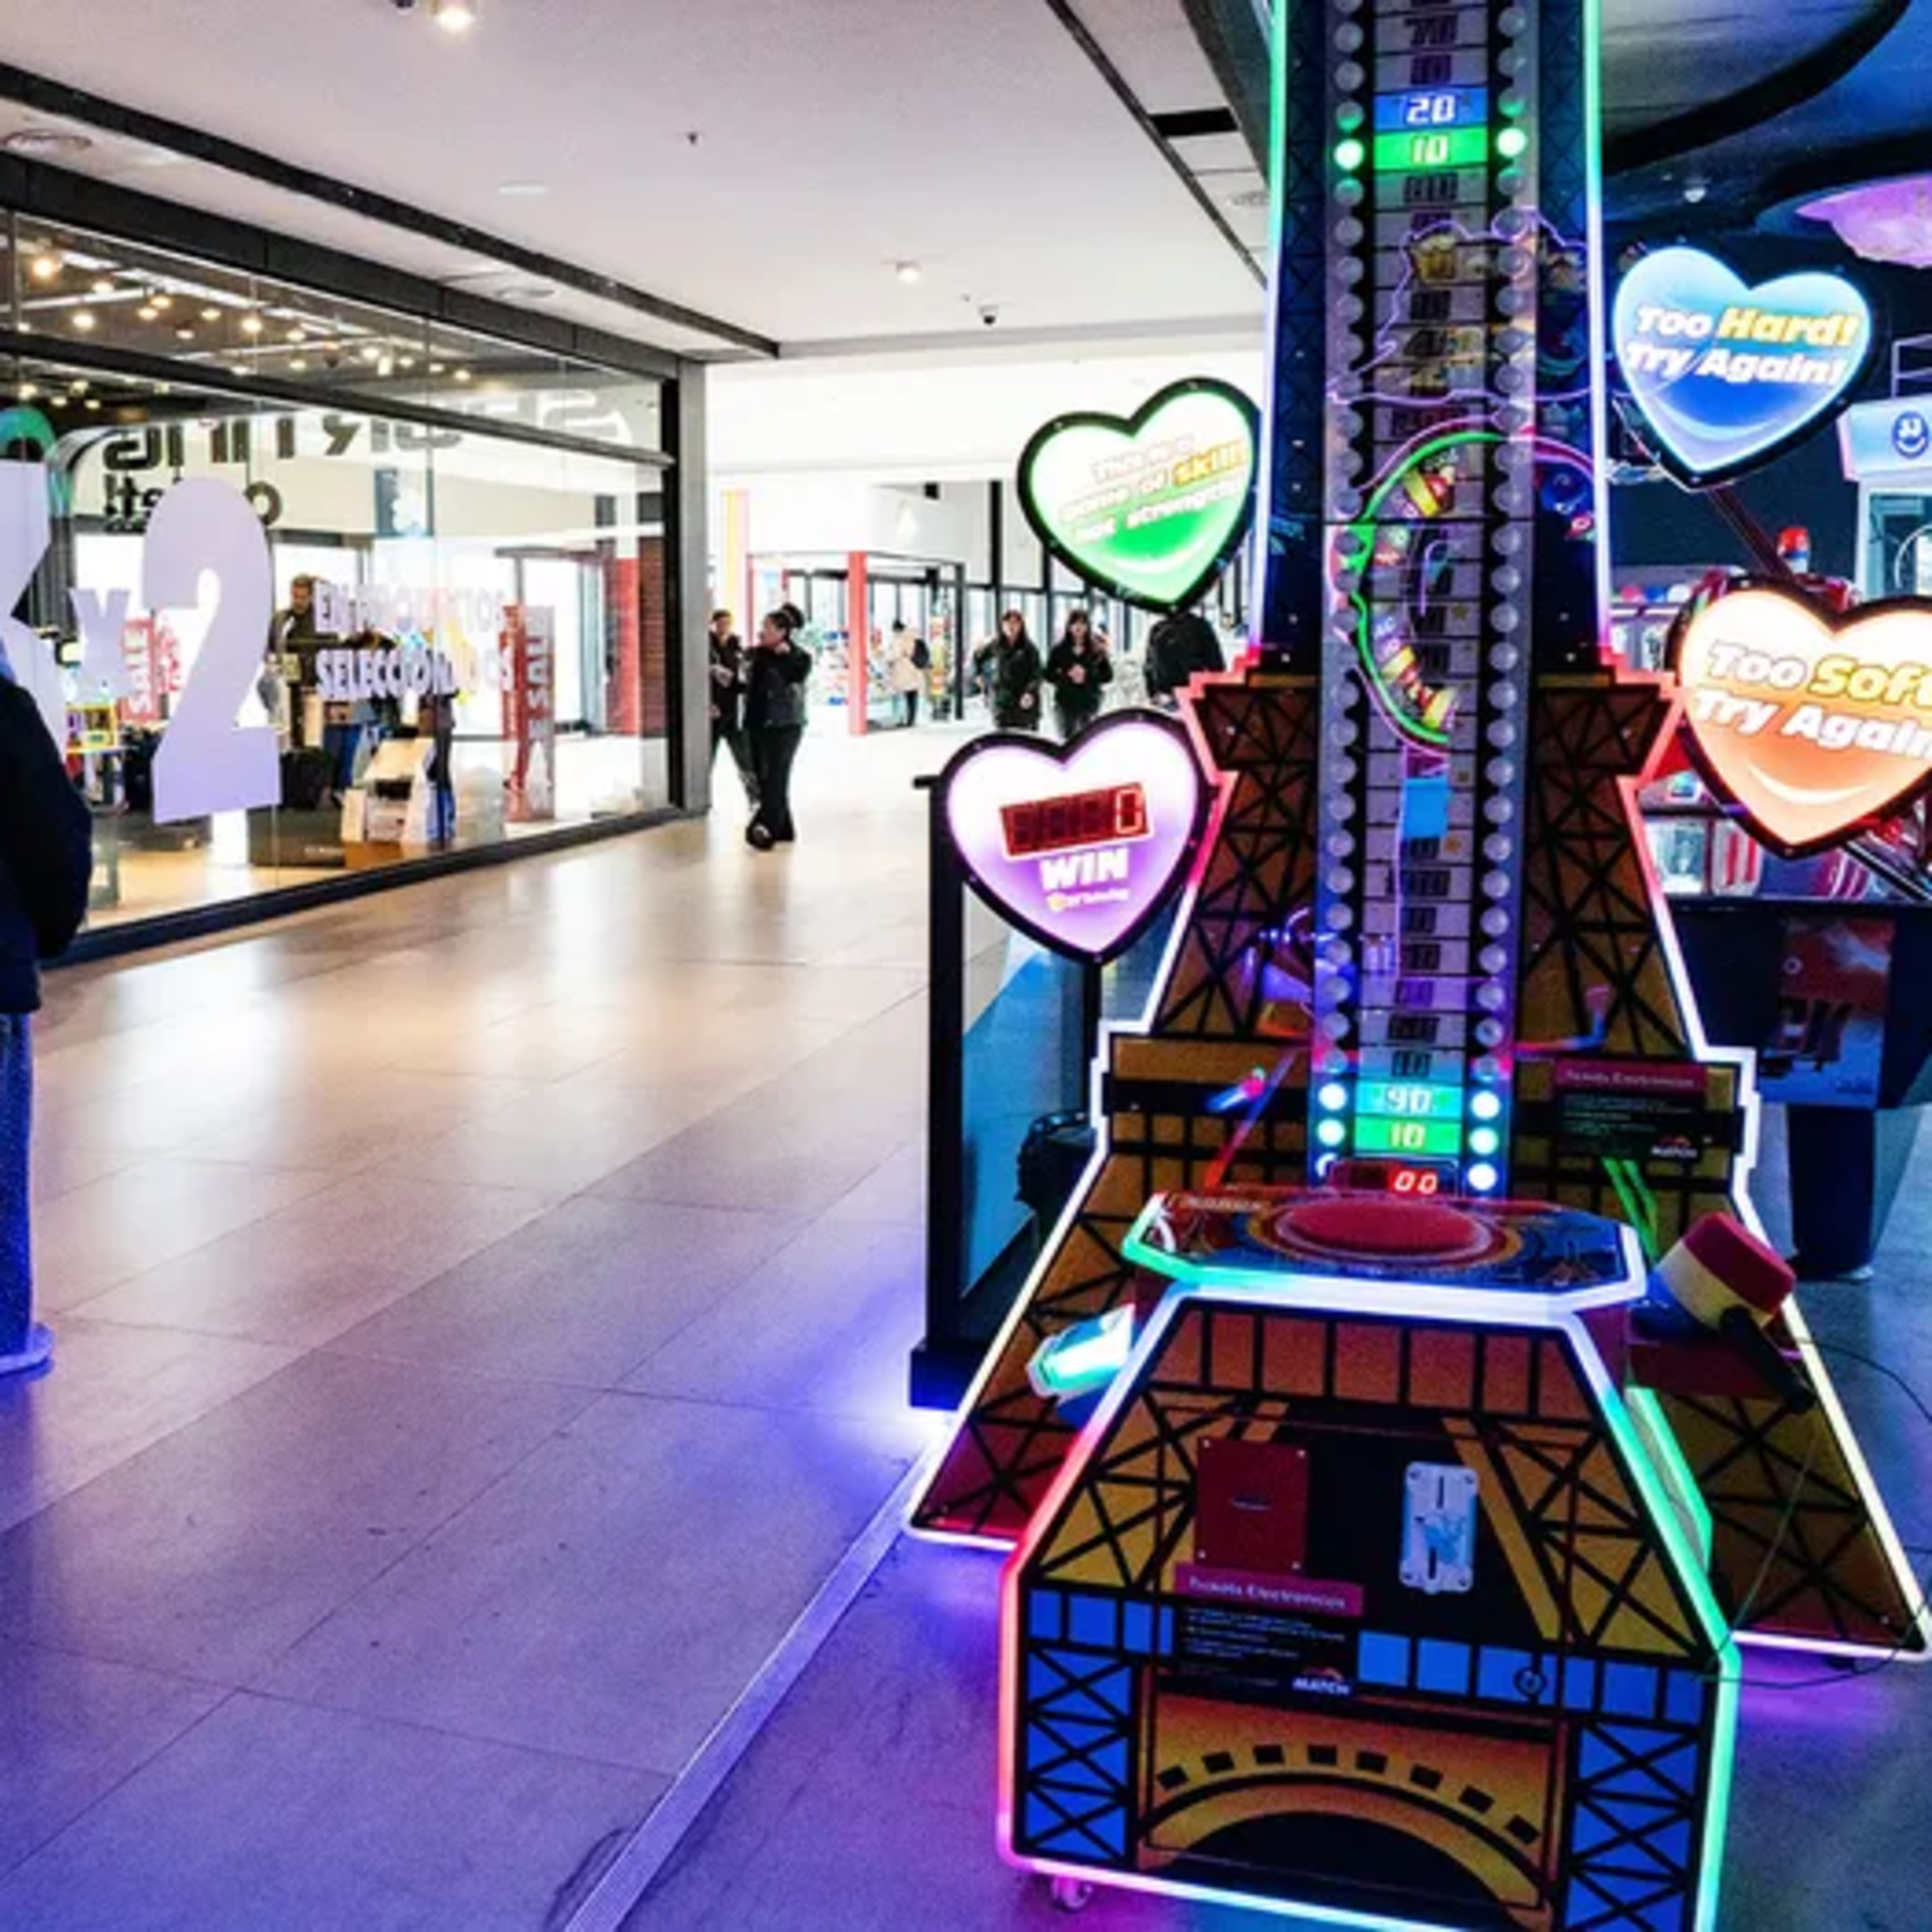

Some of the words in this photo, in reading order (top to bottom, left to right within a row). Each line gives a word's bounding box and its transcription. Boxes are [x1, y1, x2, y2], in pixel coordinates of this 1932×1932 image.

[1406, 95, 1457, 125] 20
[1412, 134, 1450, 165] 10
[1636, 307, 1712, 337] Too
[1718, 307, 1859, 346] Hard!
[1624, 343, 1701, 380] Try
[1696, 348, 1847, 384] Again!
[1709, 640, 1808, 689] Too
[1695, 685, 1784, 735] Try
[1039, 847, 1130, 890] WIN
[1390, 1122, 1427, 1148] 10
